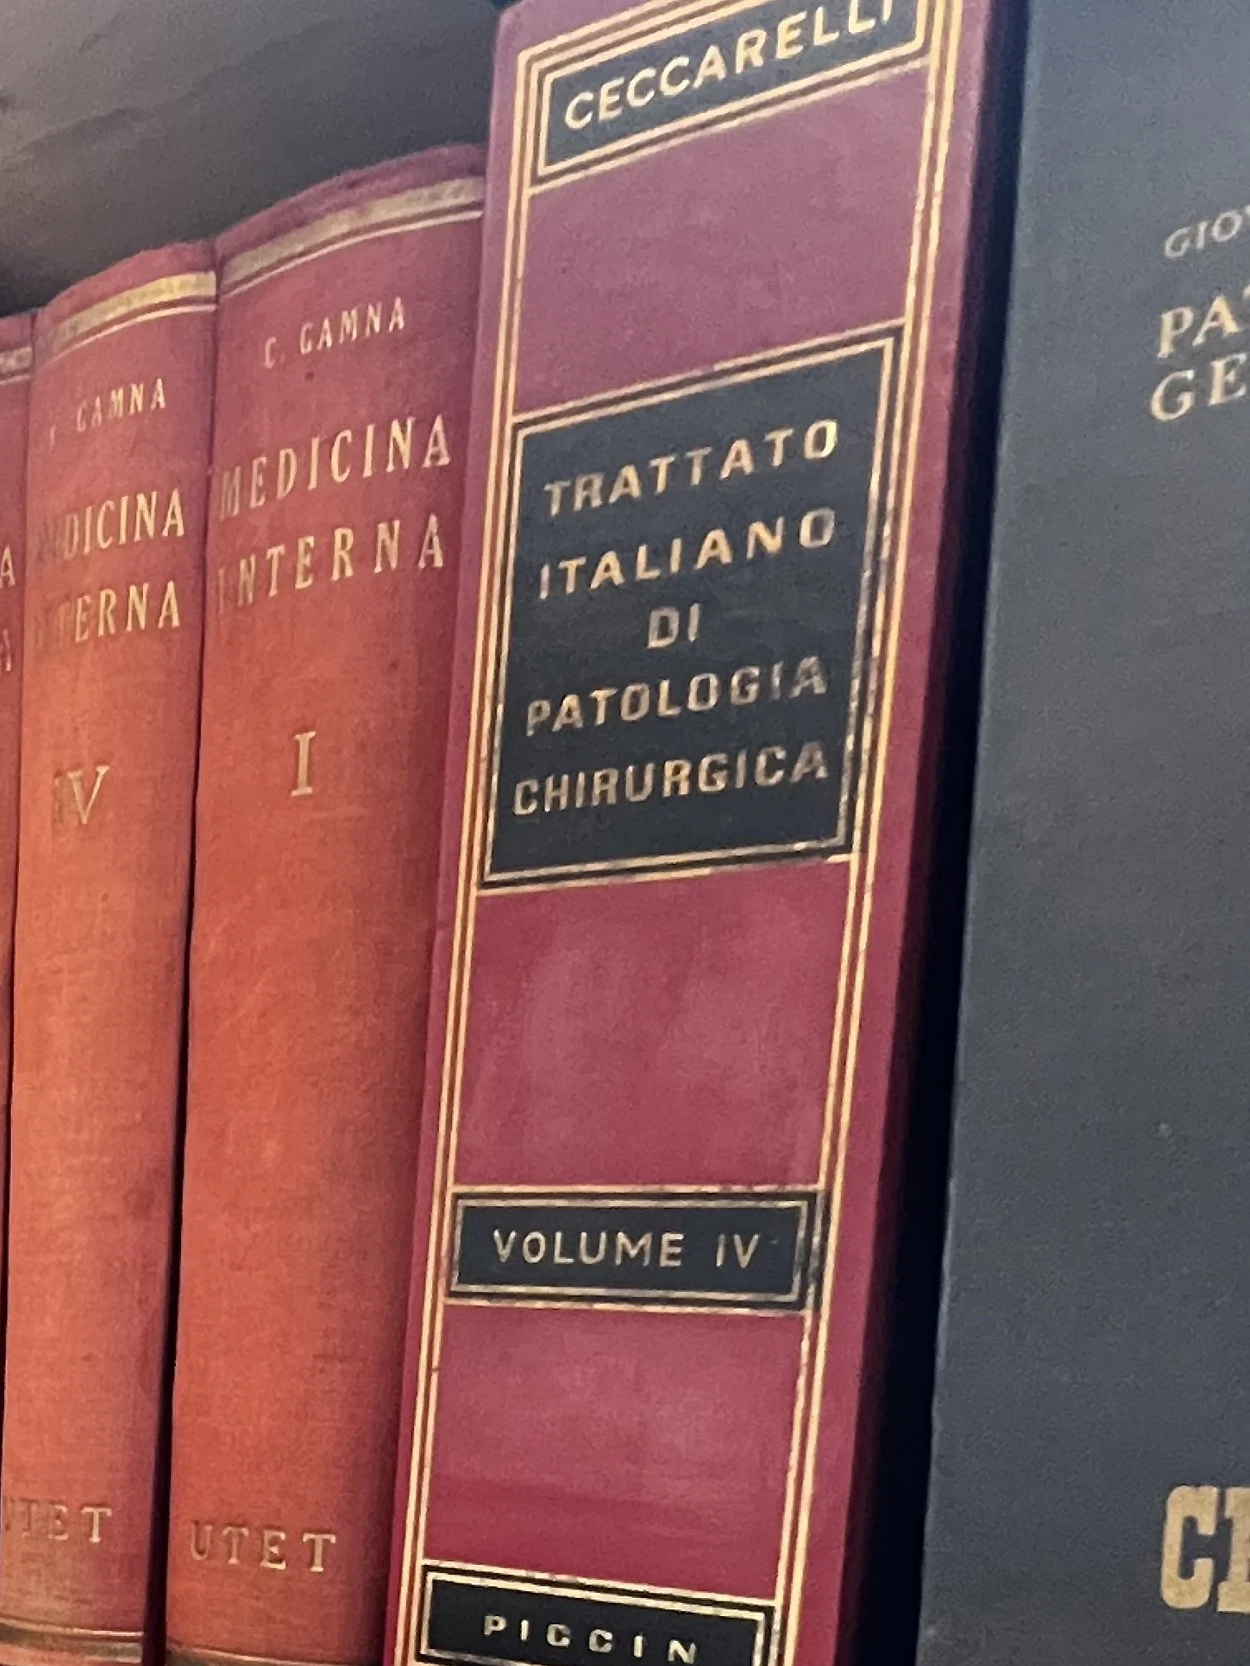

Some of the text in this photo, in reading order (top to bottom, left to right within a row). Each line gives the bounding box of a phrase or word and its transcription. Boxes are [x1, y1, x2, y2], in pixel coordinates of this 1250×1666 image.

[564, 0, 893, 131] CECCARELLI
[1164, 203, 1250, 259] GIO
[300, 296, 405, 354] GAMNA
[1157, 281, 1250, 359] PA
[77, 378, 166, 433] GAMNA
[219, 413, 451, 522] MEDICINA
[544, 418, 838, 517] TRATTATO
[38, 488, 185, 568] DICINA
[217, 511, 444, 615] INTERNA
[539, 507, 835, 601] ITALIANO
[37, 580, 181, 646] TERNA
[647, 602, 701, 649] DI
[525, 655, 827, 737] PATOLOGIA
[291, 730, 317, 797] I
[512, 740, 830, 816] CHIRURGICA
[492, 1228, 762, 1269] VOLUME IV
[190, 1519, 337, 1573] UTET
[484, 1613, 697, 1665] PICCIN
